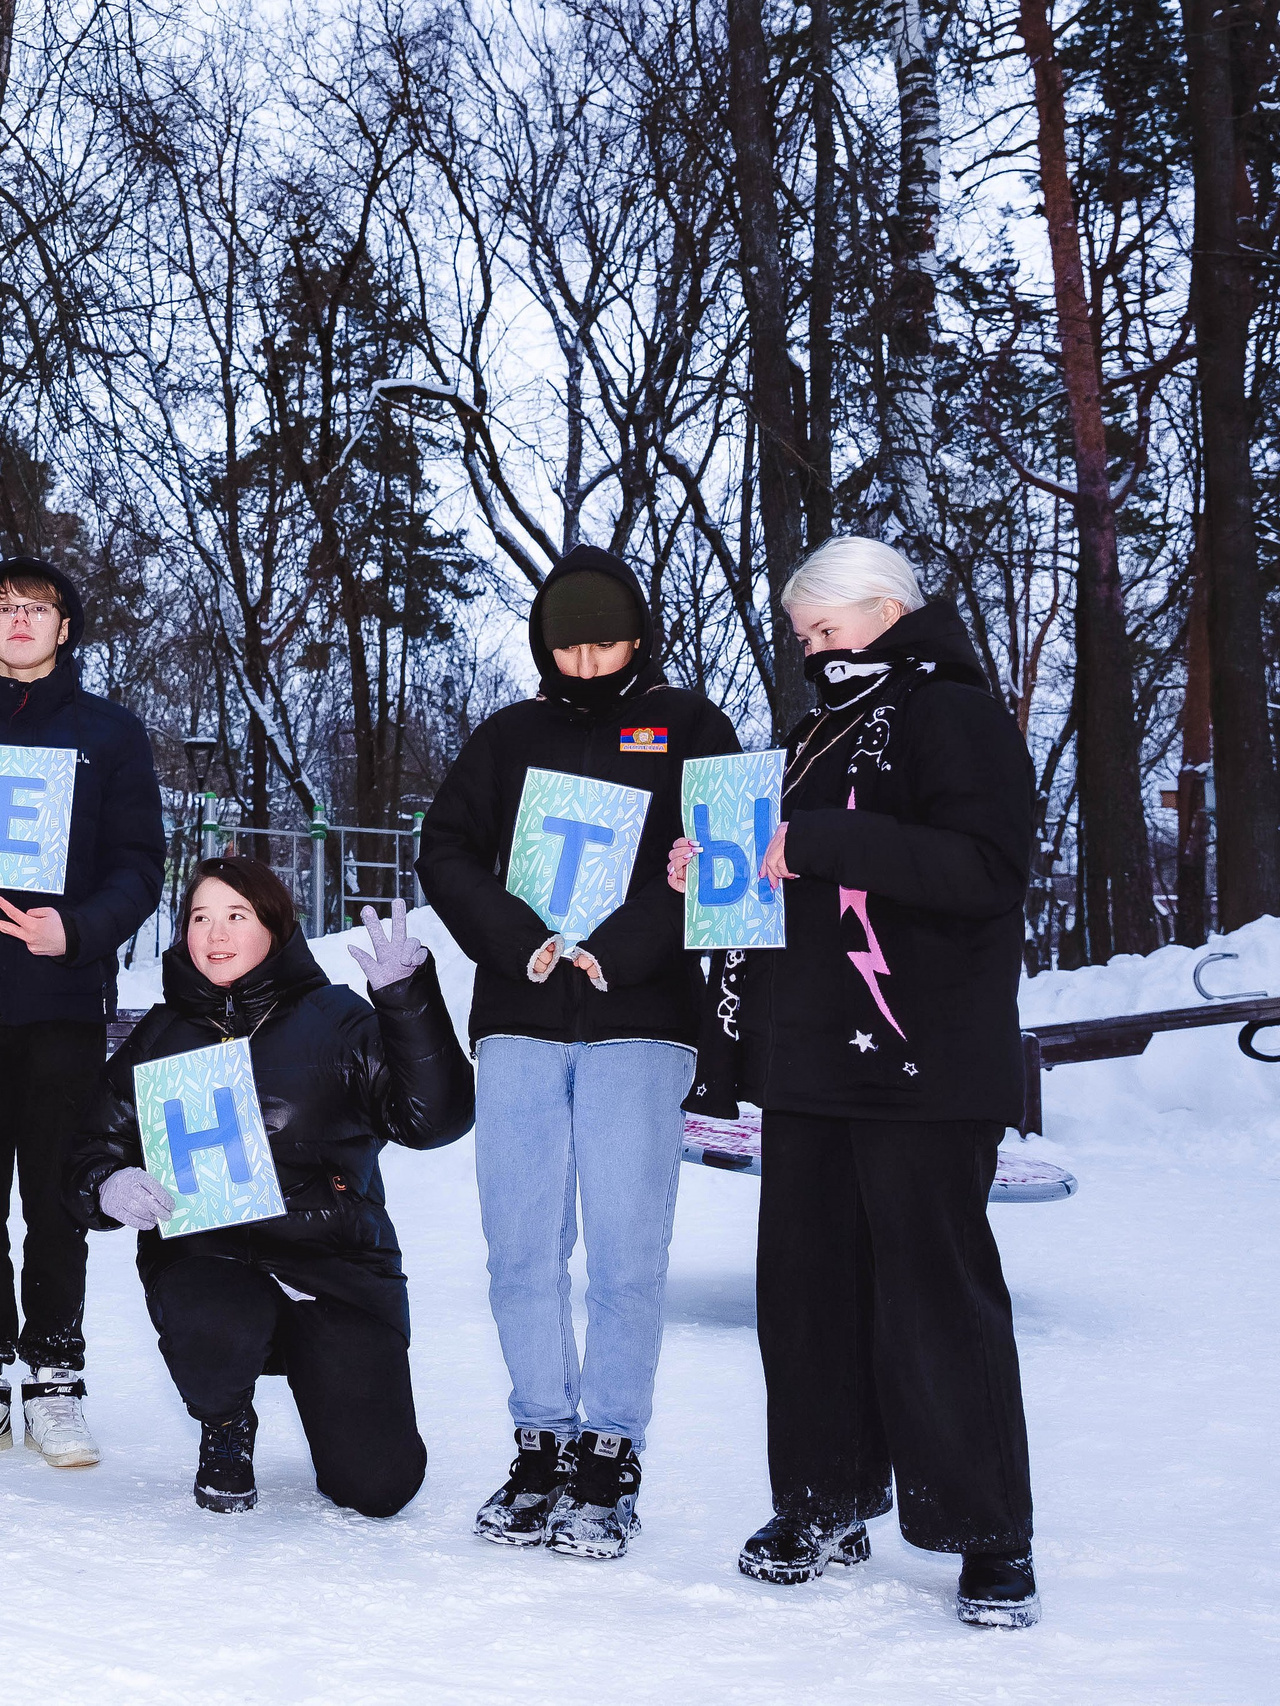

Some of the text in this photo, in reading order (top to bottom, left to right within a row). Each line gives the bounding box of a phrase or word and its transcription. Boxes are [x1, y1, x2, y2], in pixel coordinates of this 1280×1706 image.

[541, 814, 614, 917] Т
[693, 797, 776, 907] Ы
[163, 1086, 254, 1196] Н
[56, 1385, 73, 1393] NIKE
